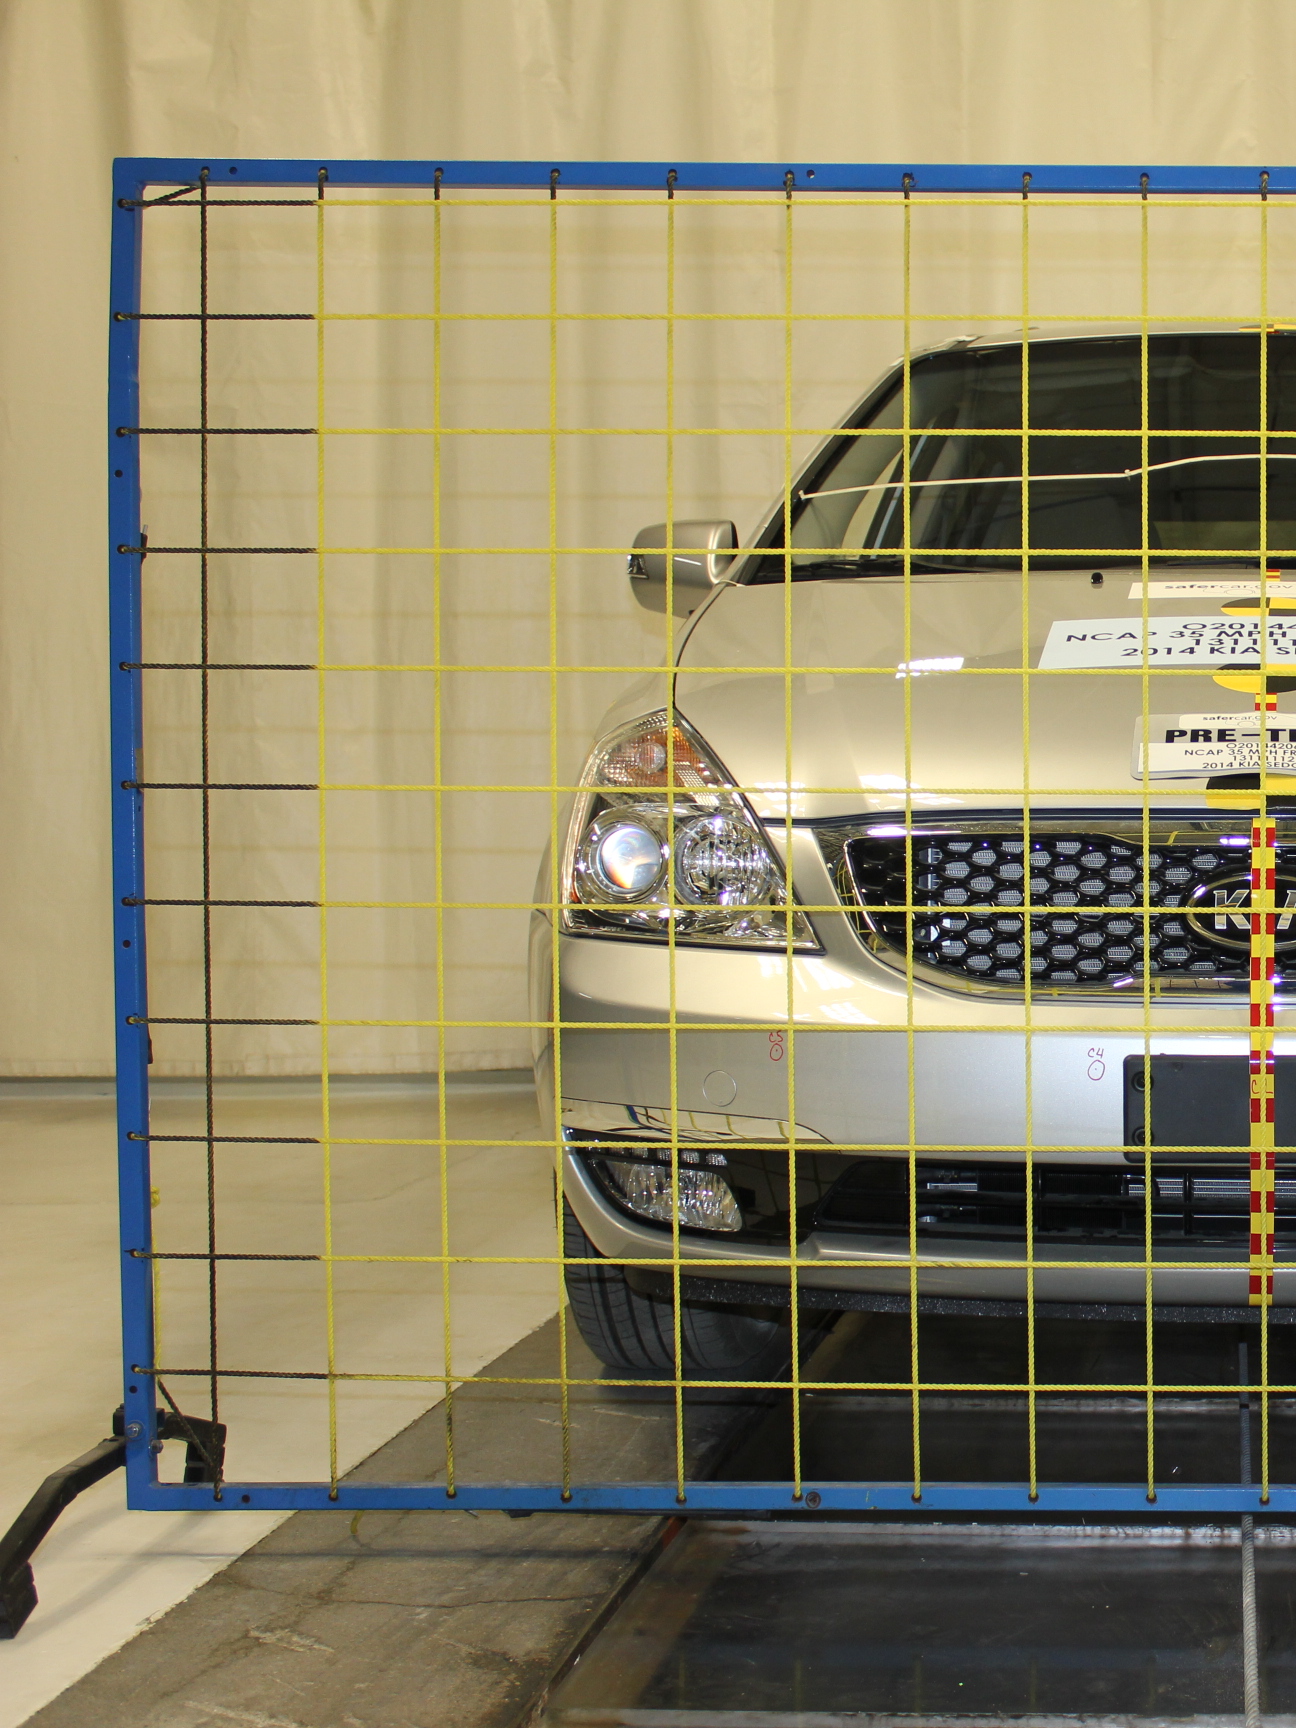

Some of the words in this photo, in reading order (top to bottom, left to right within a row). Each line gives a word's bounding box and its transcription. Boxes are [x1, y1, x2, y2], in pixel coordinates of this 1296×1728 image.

[1169, 630, 1205, 638] 35
[1215, 630, 1287, 638] MPH
[1120, 647, 1196, 656] 2014
[1209, 646, 1261, 655] KIA
[1087, 1047, 1104, 1059] C4
